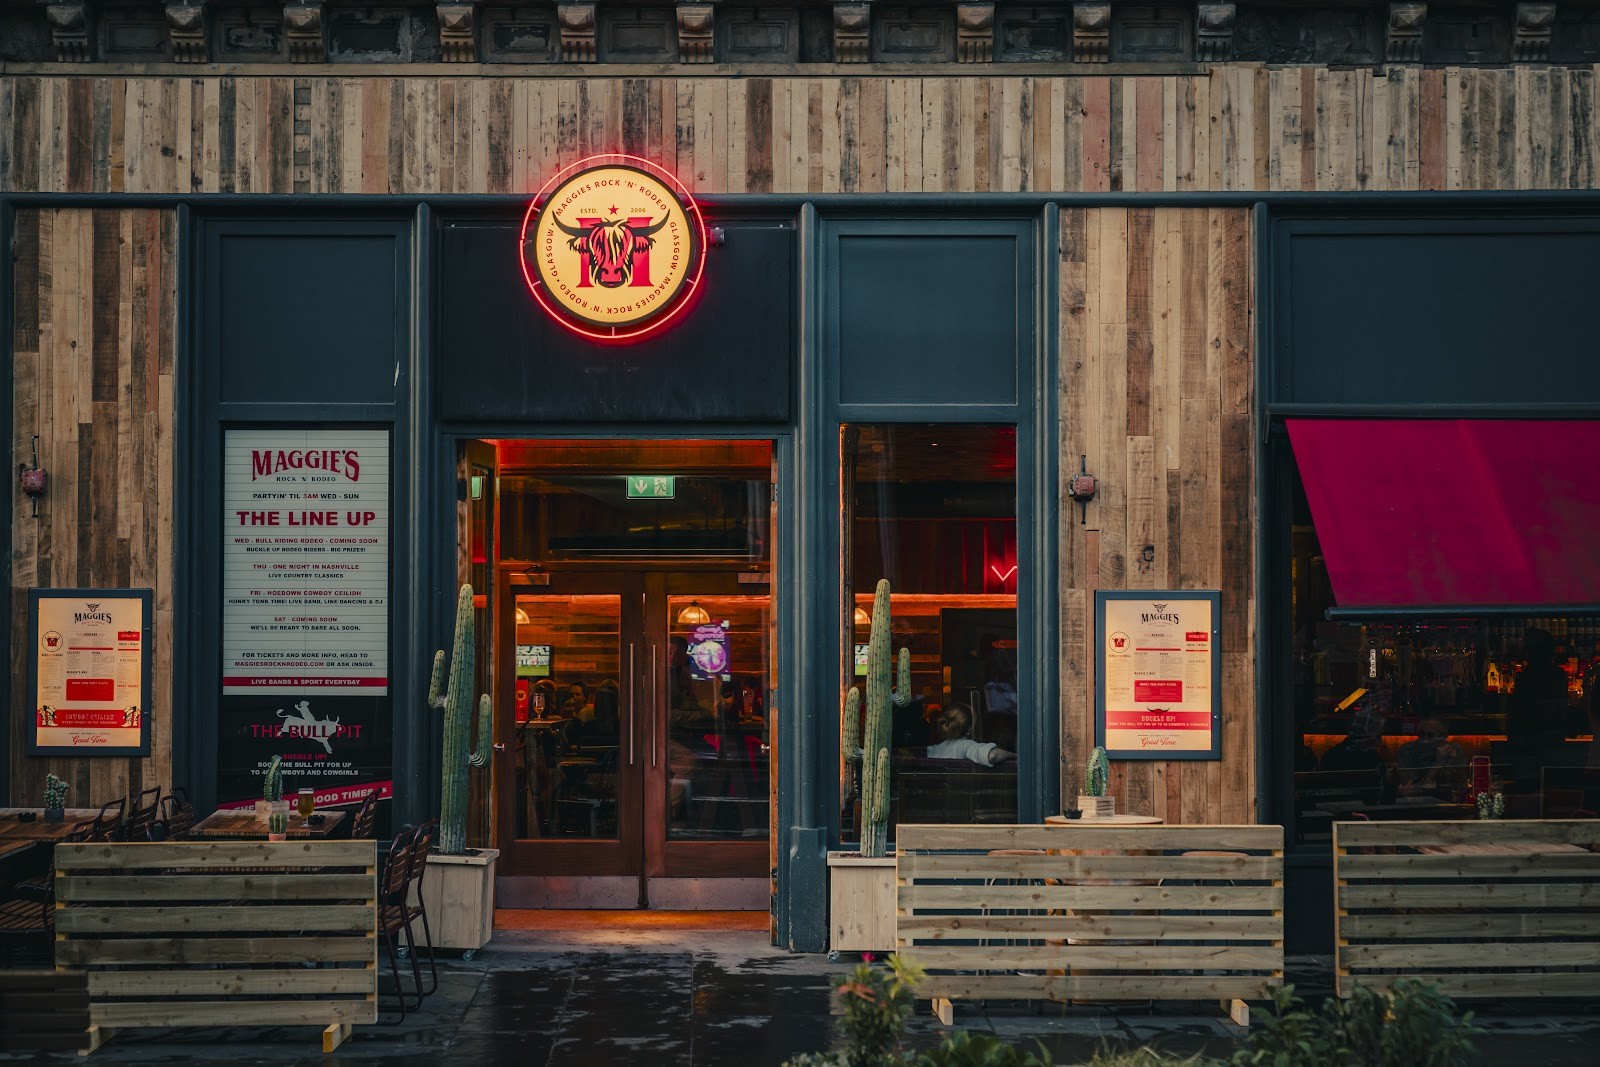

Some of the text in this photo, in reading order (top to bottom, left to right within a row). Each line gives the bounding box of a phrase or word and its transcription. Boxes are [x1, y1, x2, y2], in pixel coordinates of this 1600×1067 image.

[594, 179, 620, 188] ROCK
[556, 184, 592, 216] MAGGIES
[639, 186, 667, 210] RODEO
[546, 228, 558, 277] GLASGOW
[670, 222, 680, 270] GLASGOW
[560, 283, 588, 308] RODEO
[635, 277, 671, 309] MAGGIES
[606, 305, 632, 314] ROCK
[251, 450, 360, 482] MAGGIE'S
[236, 511, 376, 526] THE LINE UP
[72, 736, 107, 745] Good Time
[251, 725, 362, 738] THE BULL PIT
[1141, 738, 1176, 747] Good Time
[314, 794, 338, 803] OOD
